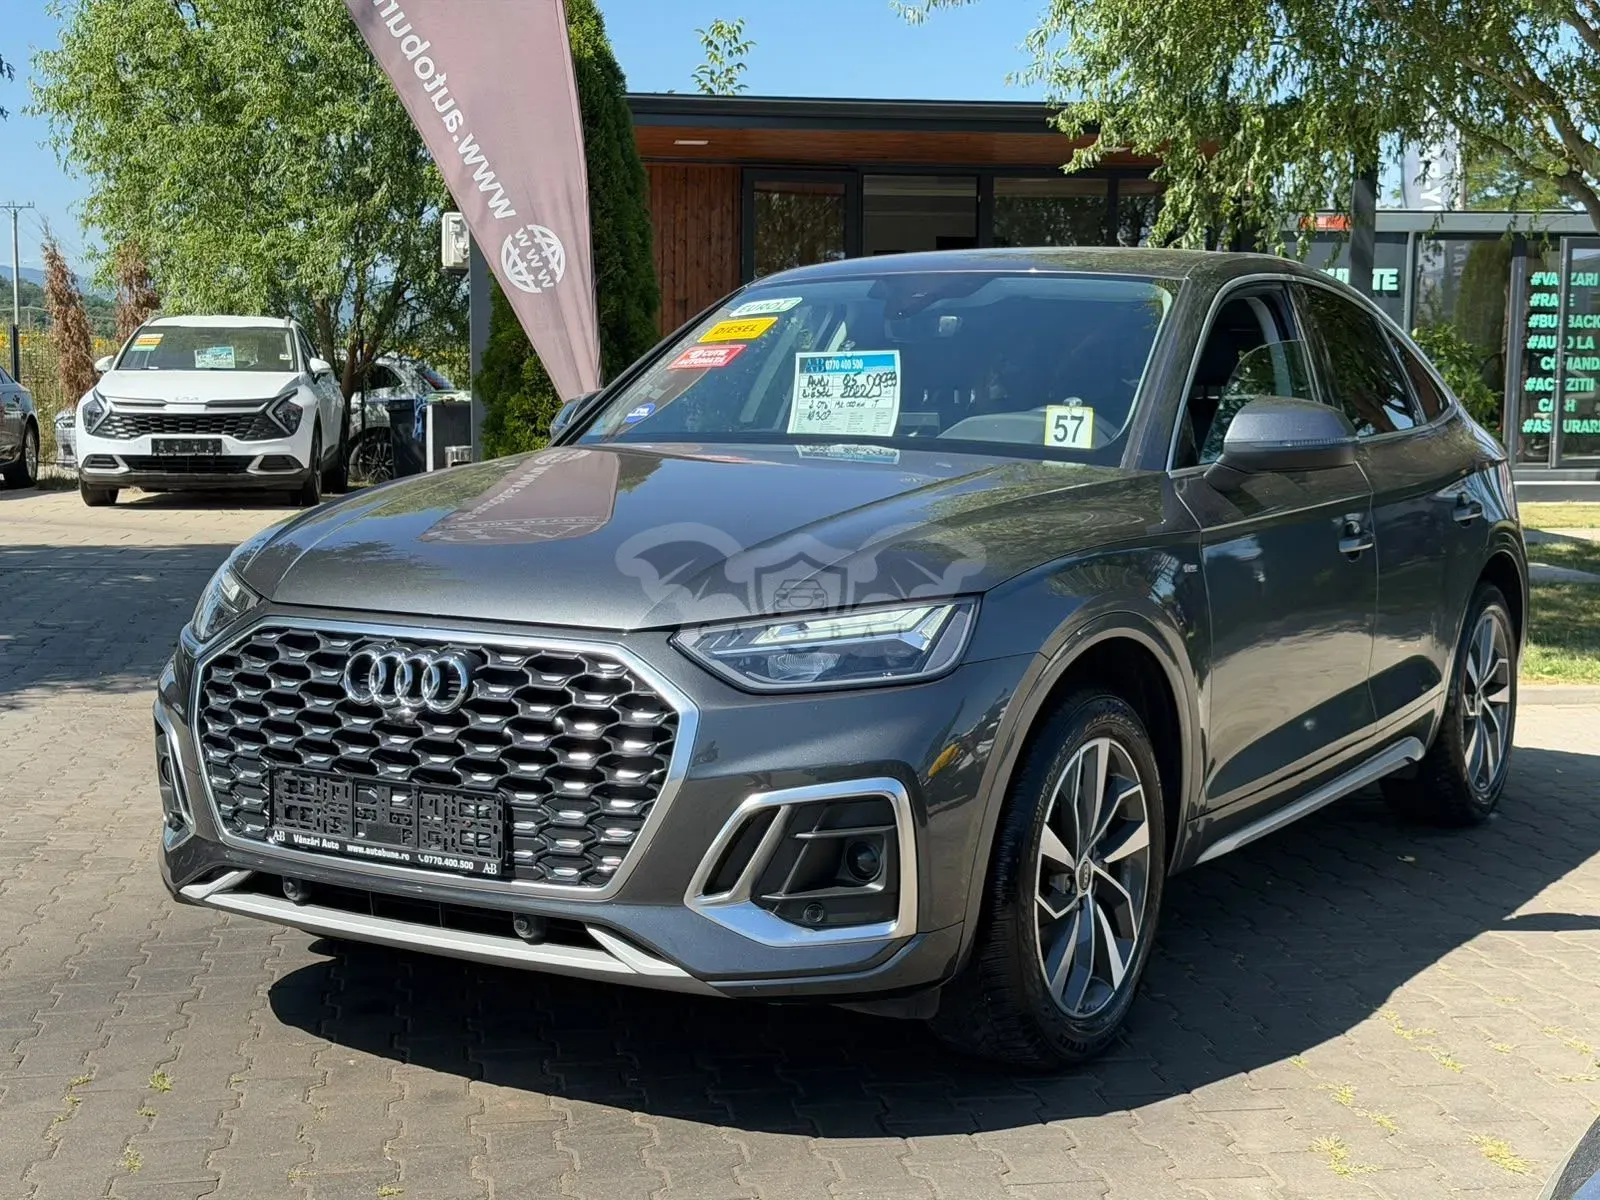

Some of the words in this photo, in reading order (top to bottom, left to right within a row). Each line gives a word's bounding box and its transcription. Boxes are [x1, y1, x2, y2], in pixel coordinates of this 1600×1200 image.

[1530, 272, 1598, 286] #VAZARI
[714, 325, 757, 335] DIESEL
[1577, 335, 1595, 349] LA
[1053, 415, 1084, 443] 57
[321, 838, 339, 850] Auto
[346, 844, 410, 861] www.autobune.ro
[424, 855, 474, 870] 0770.400.500
